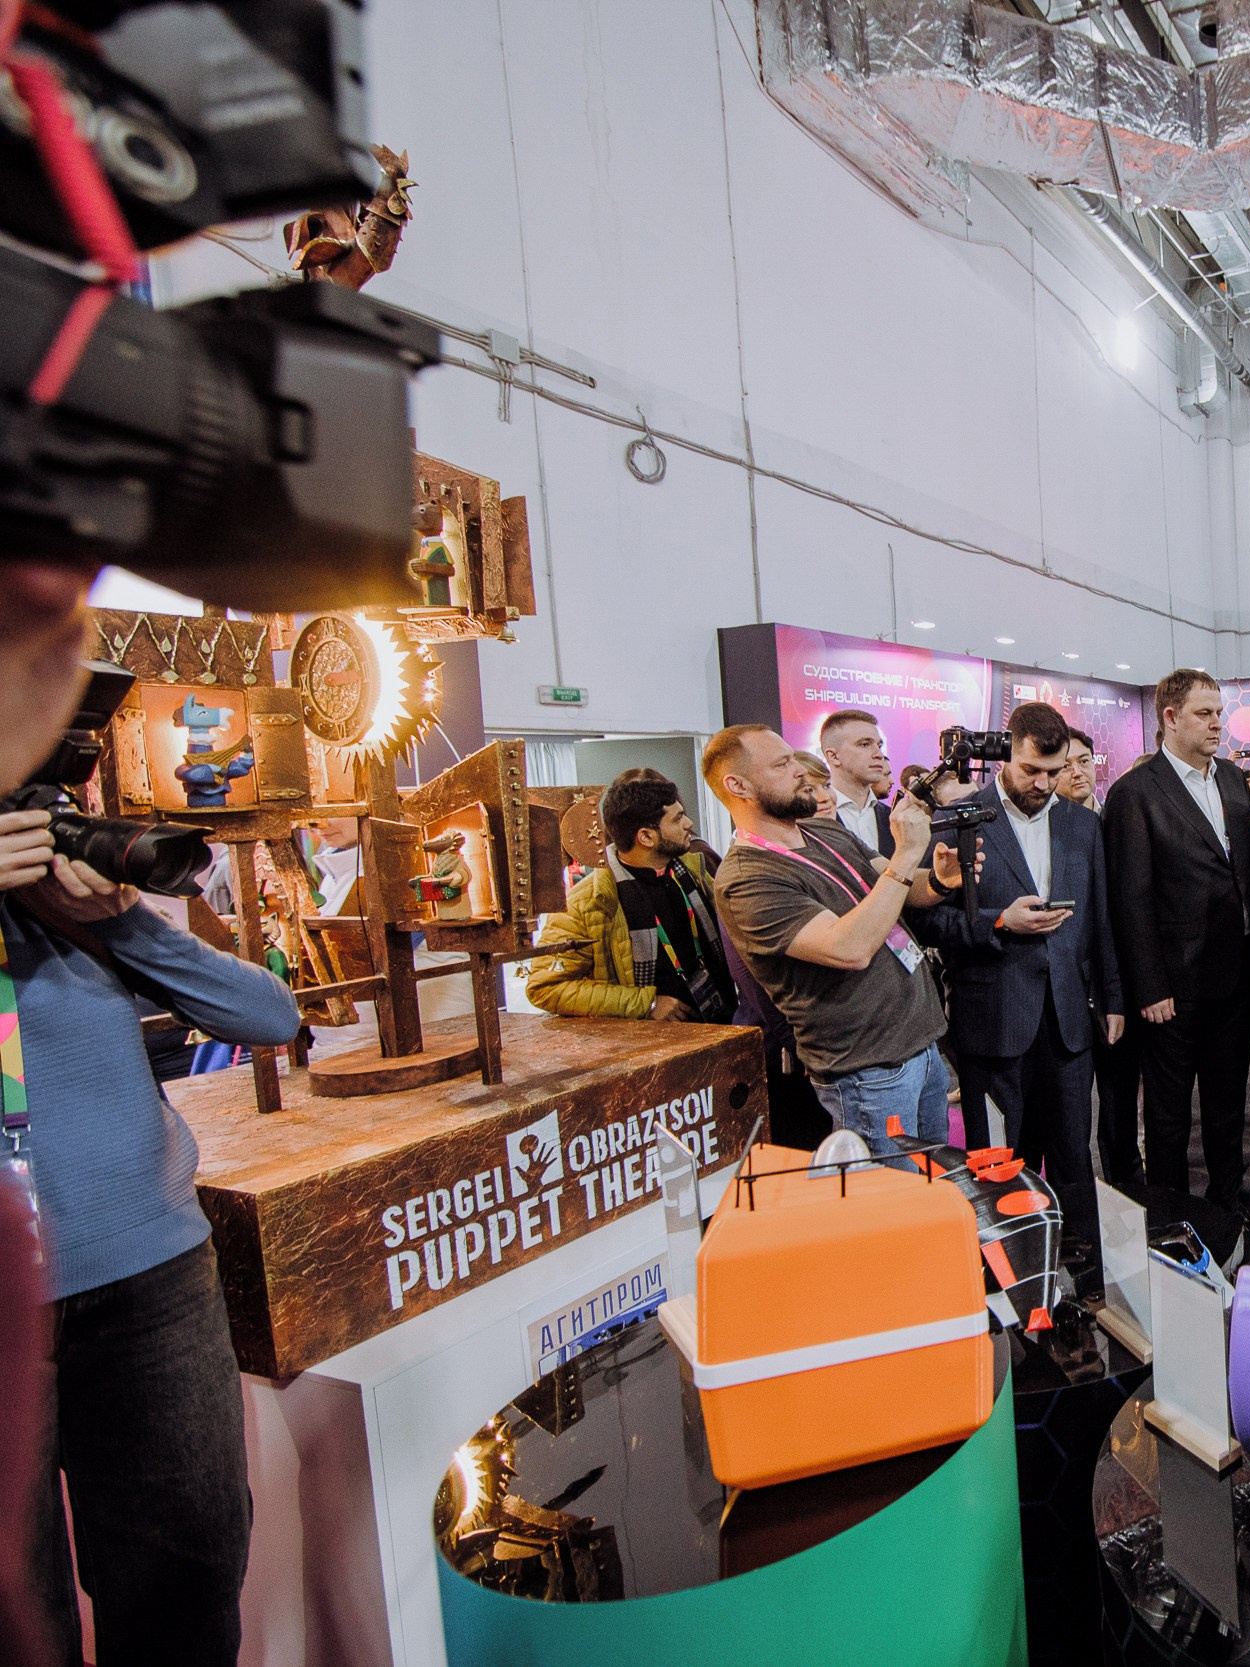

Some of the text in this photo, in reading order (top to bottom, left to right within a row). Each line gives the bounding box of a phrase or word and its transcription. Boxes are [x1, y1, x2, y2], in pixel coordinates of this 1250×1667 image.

[803, 664, 903, 687] СУДОСТРОЕНИЕ
[910, 677, 969, 694] ТРАНСПОР
[804, 688, 891, 707] SHIPBUILDING
[898, 697, 961, 712] TRANSPORT
[382, 1085, 714, 1249] SERGEI OBRAZTSOV
[386, 1121, 720, 1311] PUPPET THEARE
[541, 1263, 663, 1355] АГИТПРОМ
